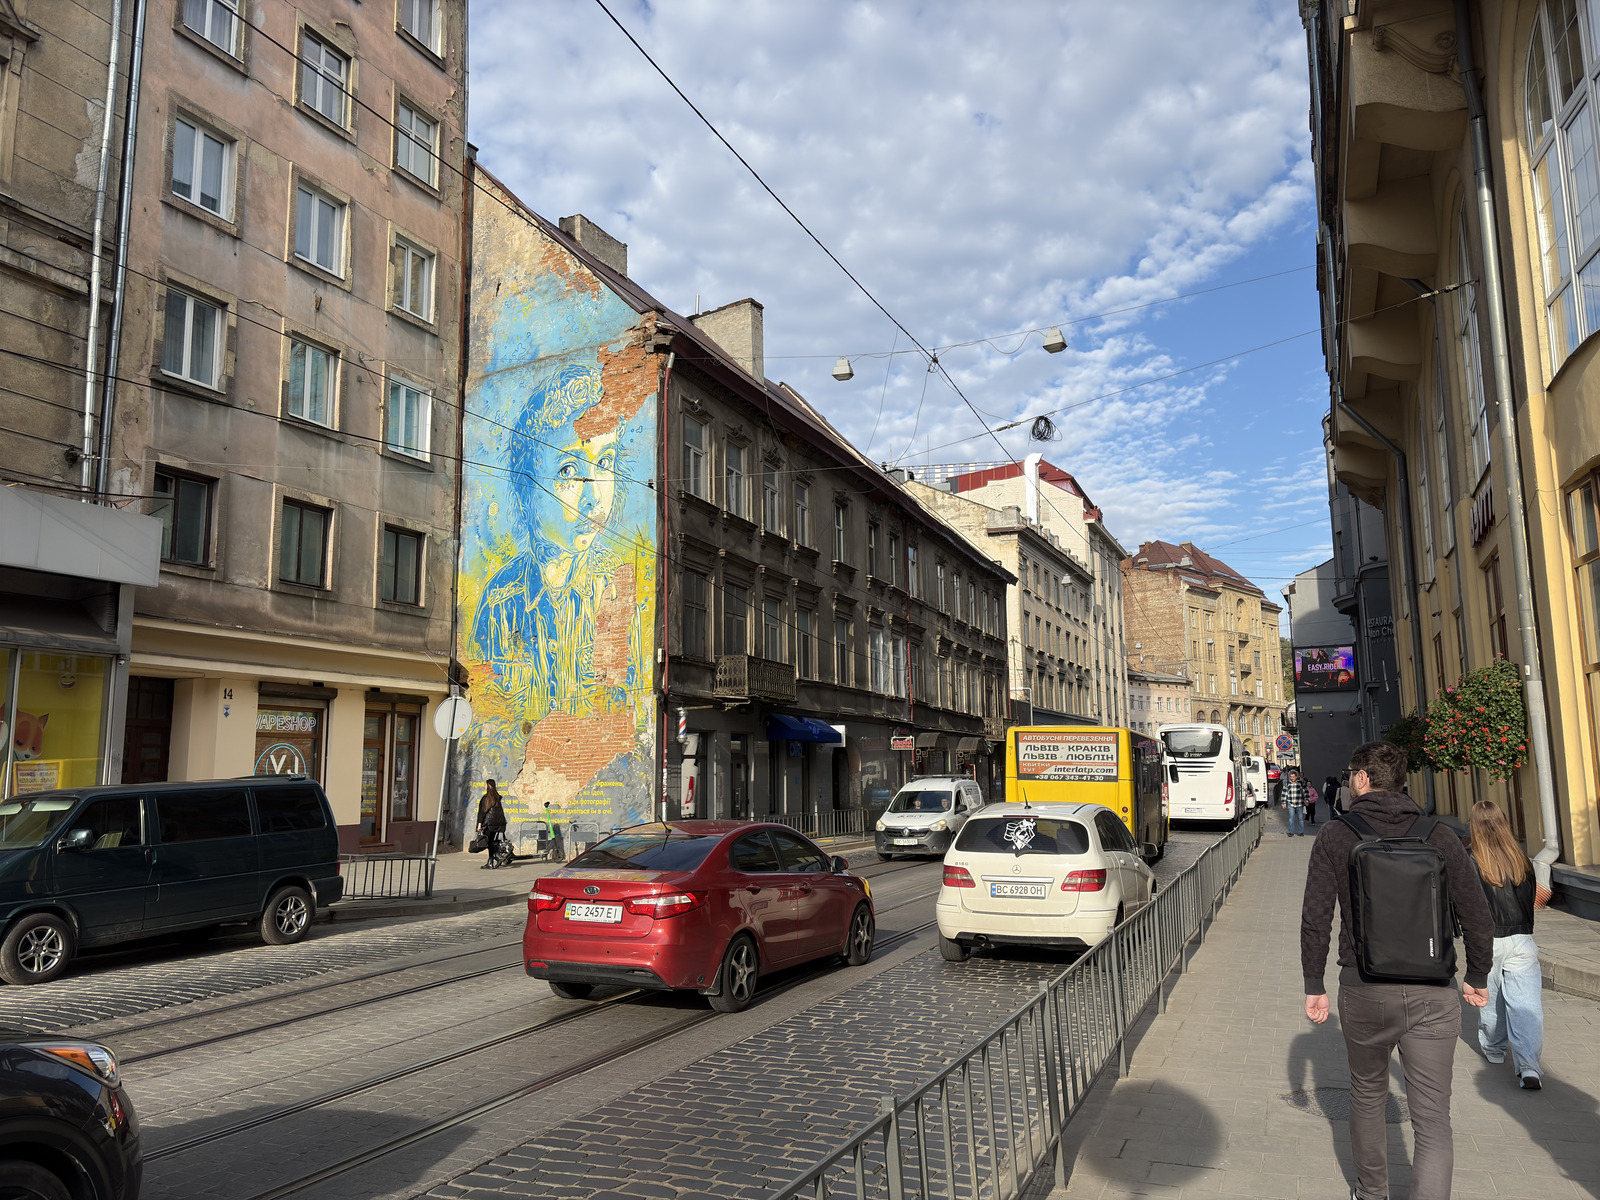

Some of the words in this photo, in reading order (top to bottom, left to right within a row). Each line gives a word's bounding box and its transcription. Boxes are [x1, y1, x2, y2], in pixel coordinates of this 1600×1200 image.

[1307, 664, 1323, 672] EASY
[1323, 662, 1341, 670] RIDER
[223, 688, 233, 699] 14
[1025, 744, 1060, 752] ЛЬВІВ
[1054, 765, 1114, 774] interlatp.com
[579, 798, 611, 806] фотографії
[566, 807, 590, 815] дивіться
[996, 885, 1008, 894] BC
[1009, 885, 1028, 895] 6928
[1030, 886, 1043, 895] OH
[570, 905, 583, 916] BC
[584, 906, 605, 918] 2457
[606, 907, 618, 919] EI
